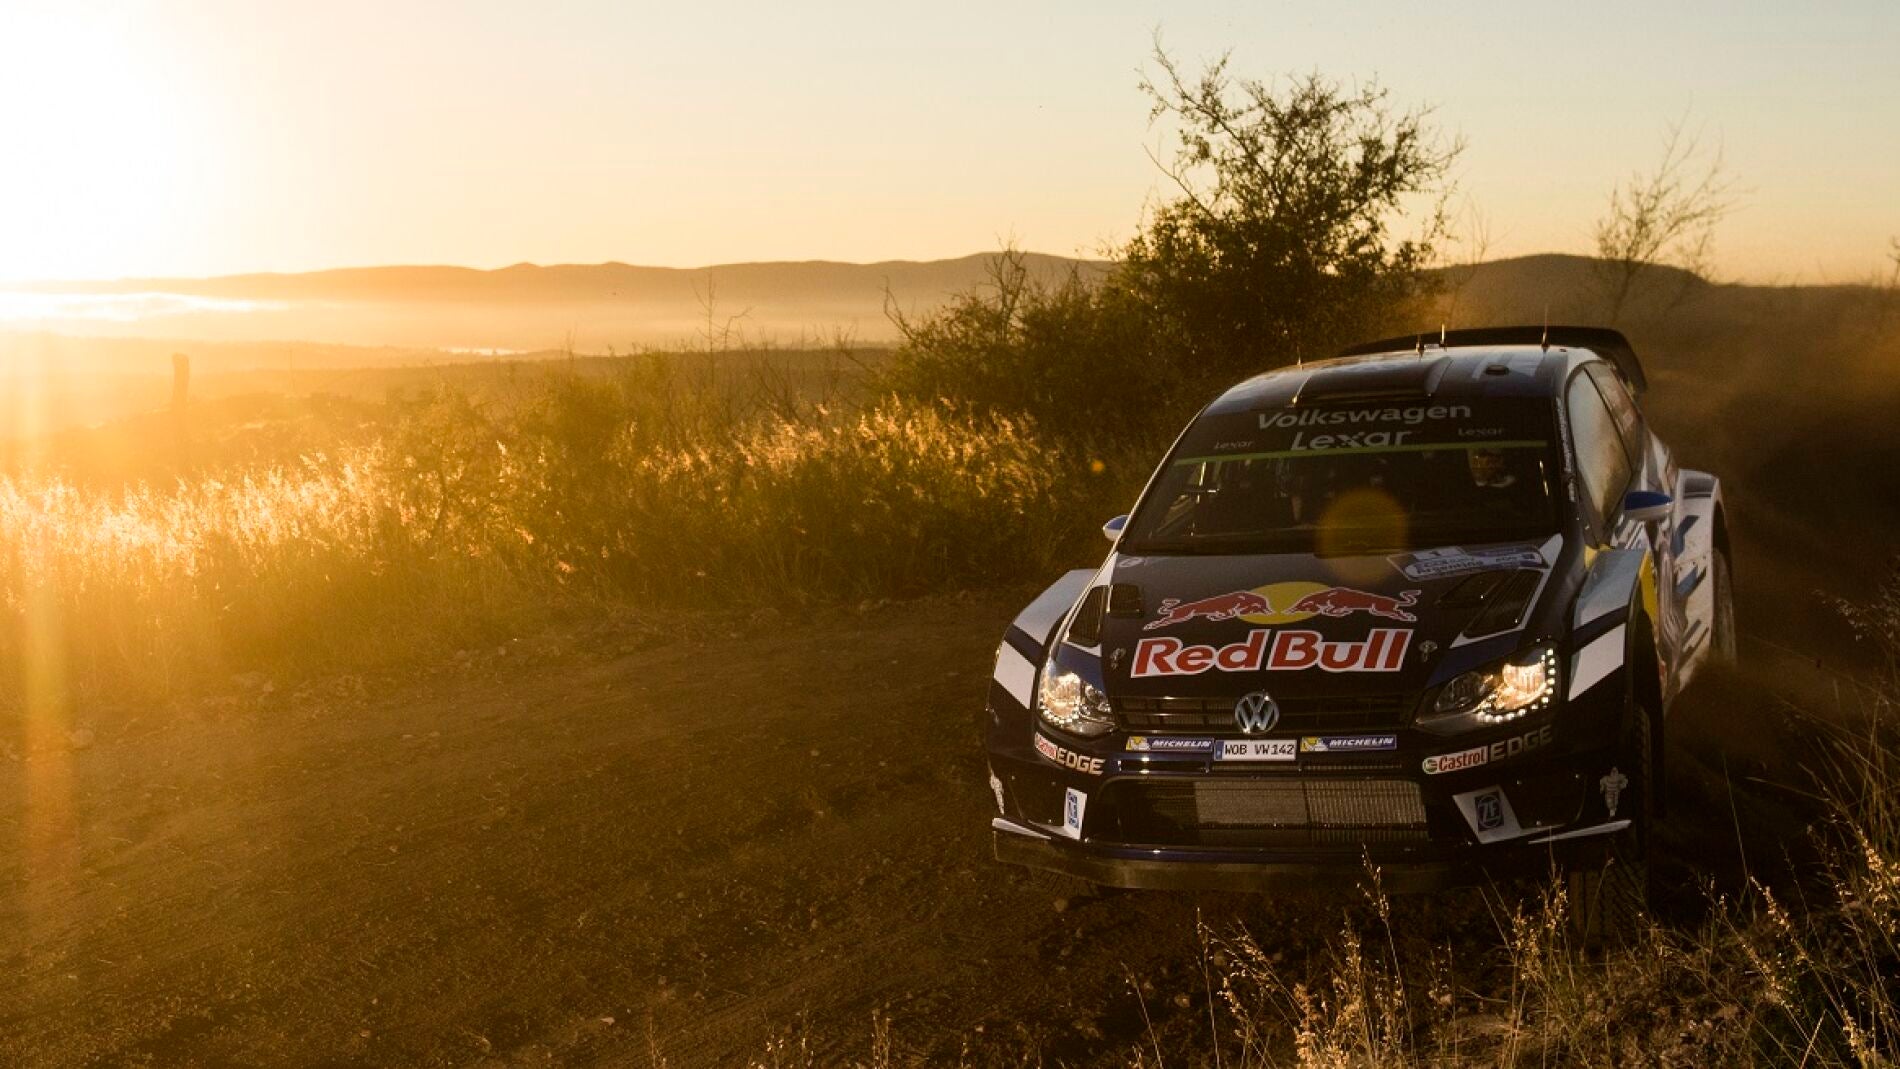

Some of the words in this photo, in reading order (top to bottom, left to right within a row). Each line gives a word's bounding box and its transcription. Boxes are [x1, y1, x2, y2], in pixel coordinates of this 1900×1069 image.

[1258, 403, 1472, 430] Volkswagen
[1290, 430, 1414, 450] Lexar
[1131, 629, 1271, 678] Red
[1266, 629, 1413, 672] Bull
[1151, 739, 1211, 749] MICHELIN
[1225, 743, 1248, 756] WOB
[1329, 737, 1394, 748] MICHELIN
[1439, 750, 1486, 772] Castrol
[1490, 725, 1552, 762] EDGE
[1057, 748, 1107, 775] EDGE
